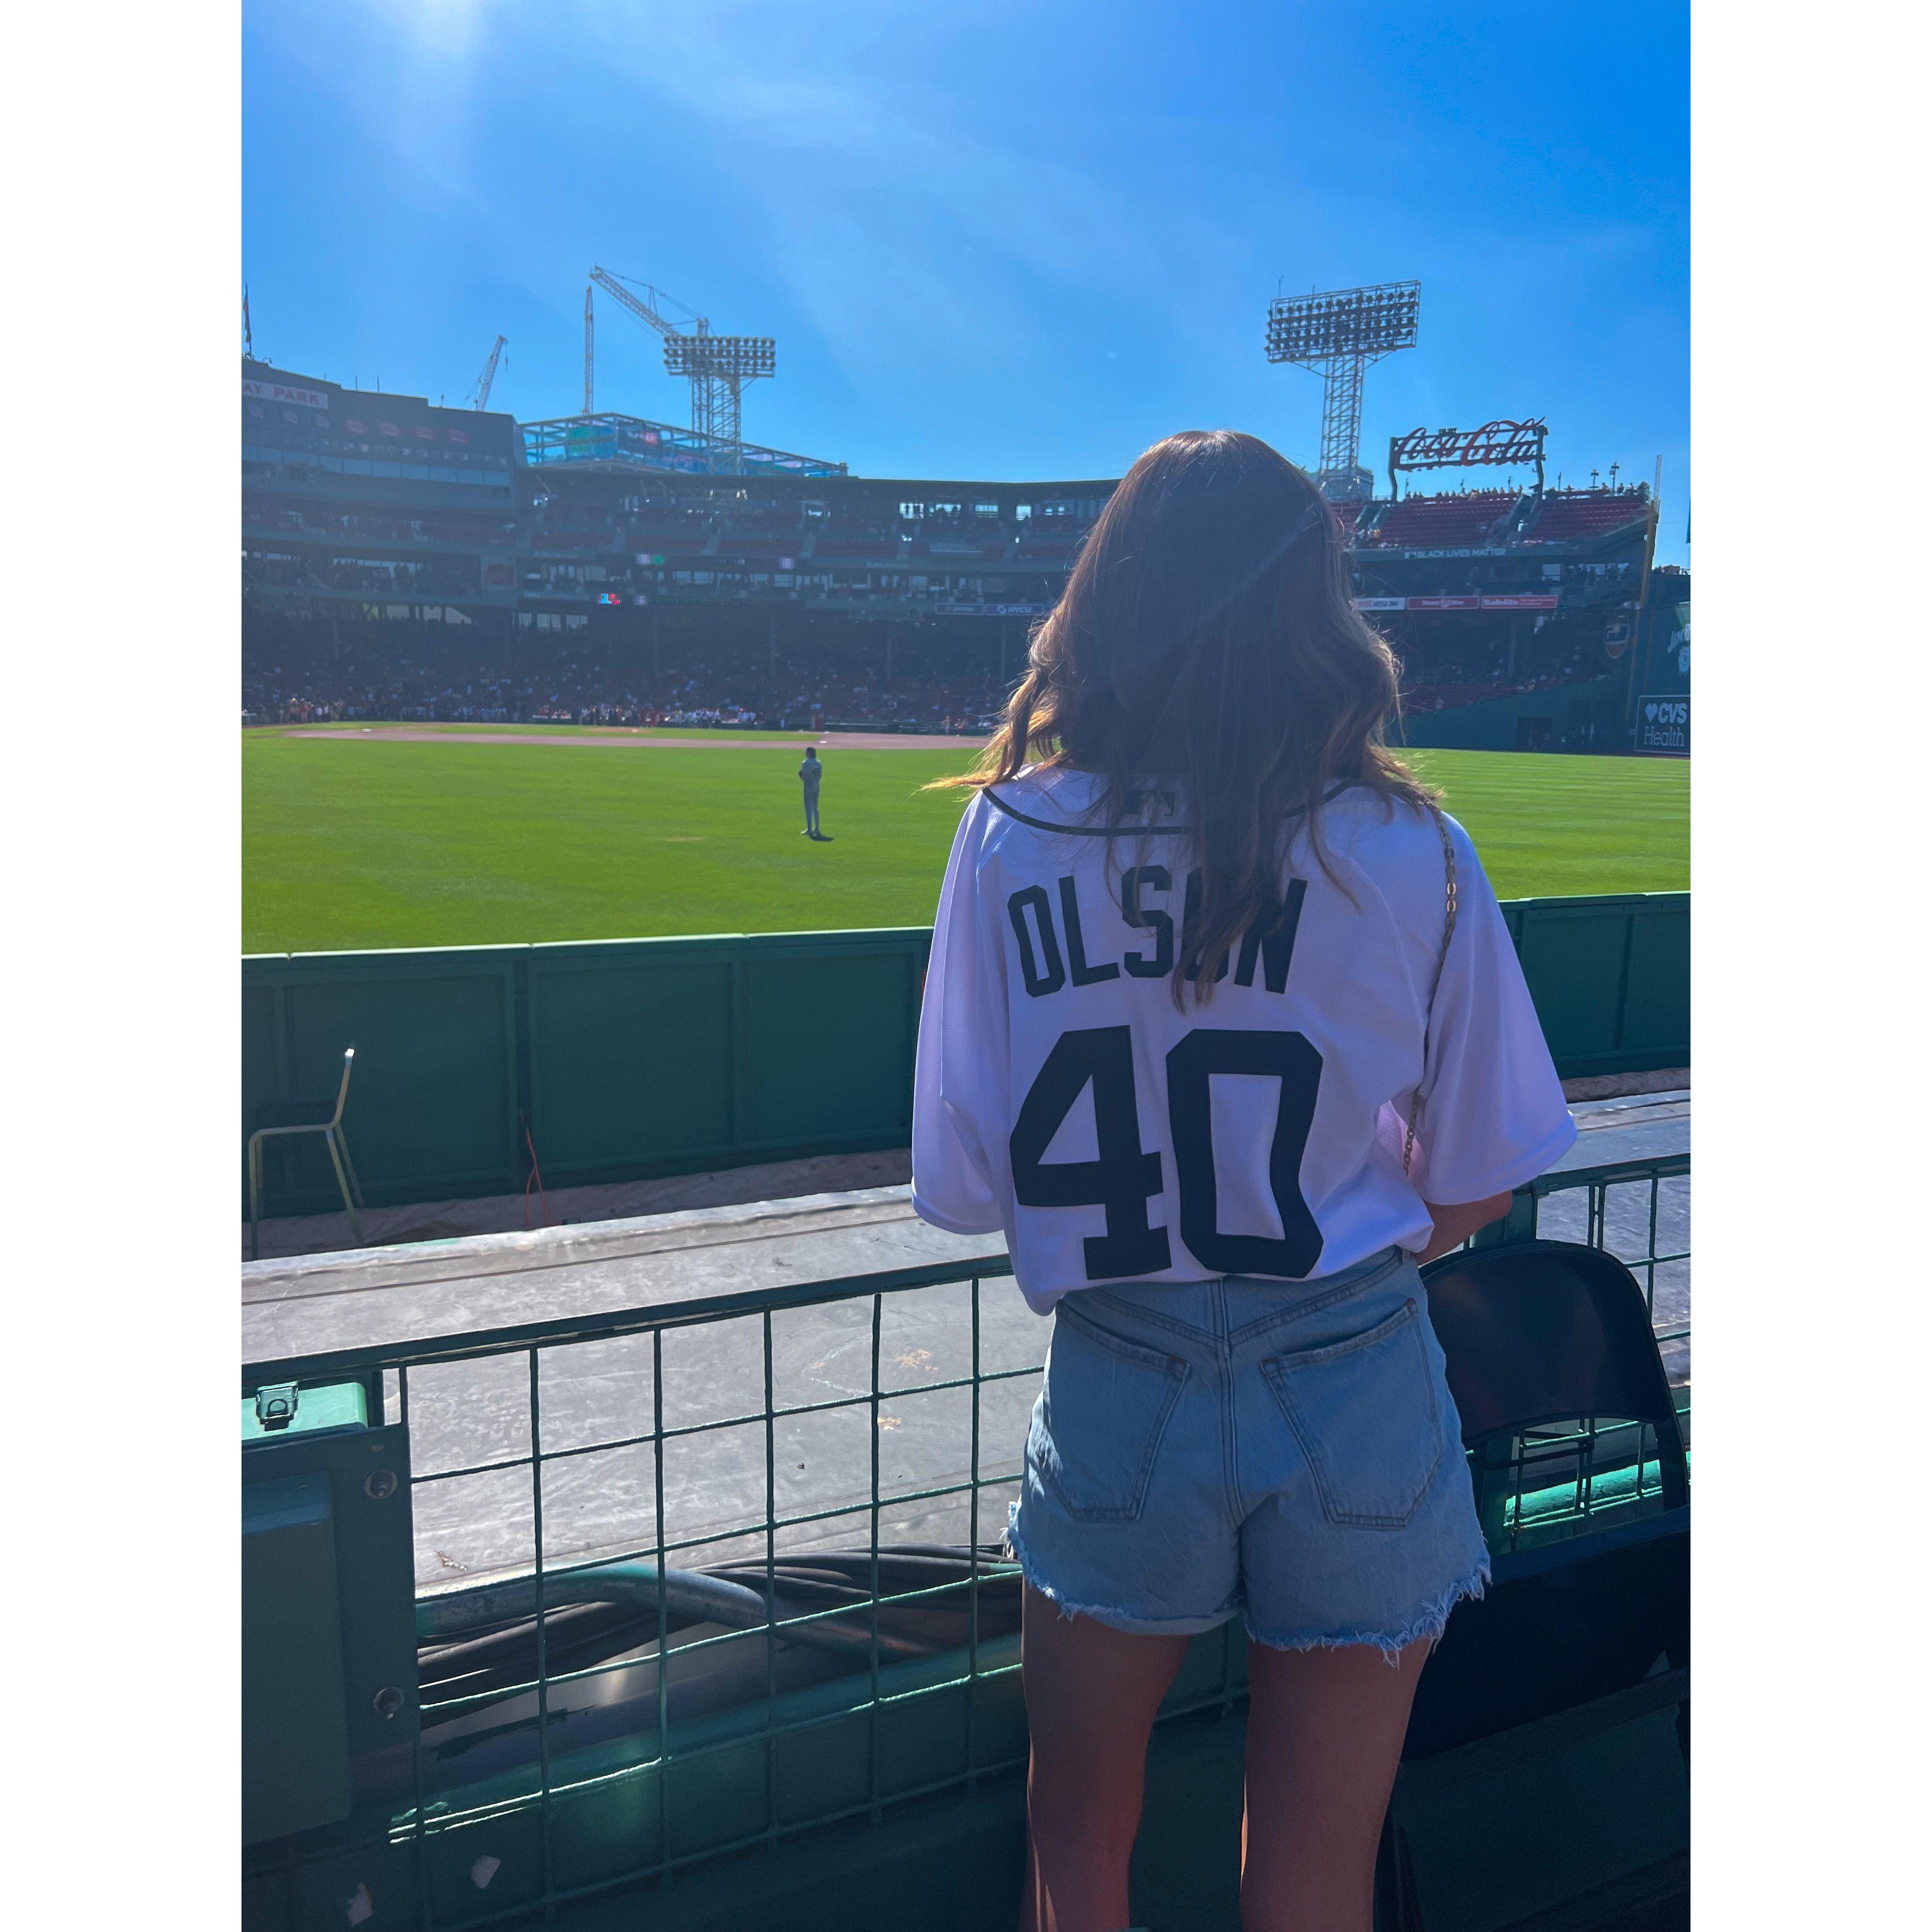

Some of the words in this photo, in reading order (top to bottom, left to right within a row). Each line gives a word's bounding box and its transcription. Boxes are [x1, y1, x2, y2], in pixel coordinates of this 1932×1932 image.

[273, 387, 319, 405] PARK
[1417, 550, 1444, 559] BLACK
[1446, 549, 1470, 557] LIVES
[1472, 548, 1506, 556] MATTER
[1658, 702, 1687, 724] CVS
[1643, 725, 1684, 747] Health
[1009, 1025, 1324, 1280] 40
